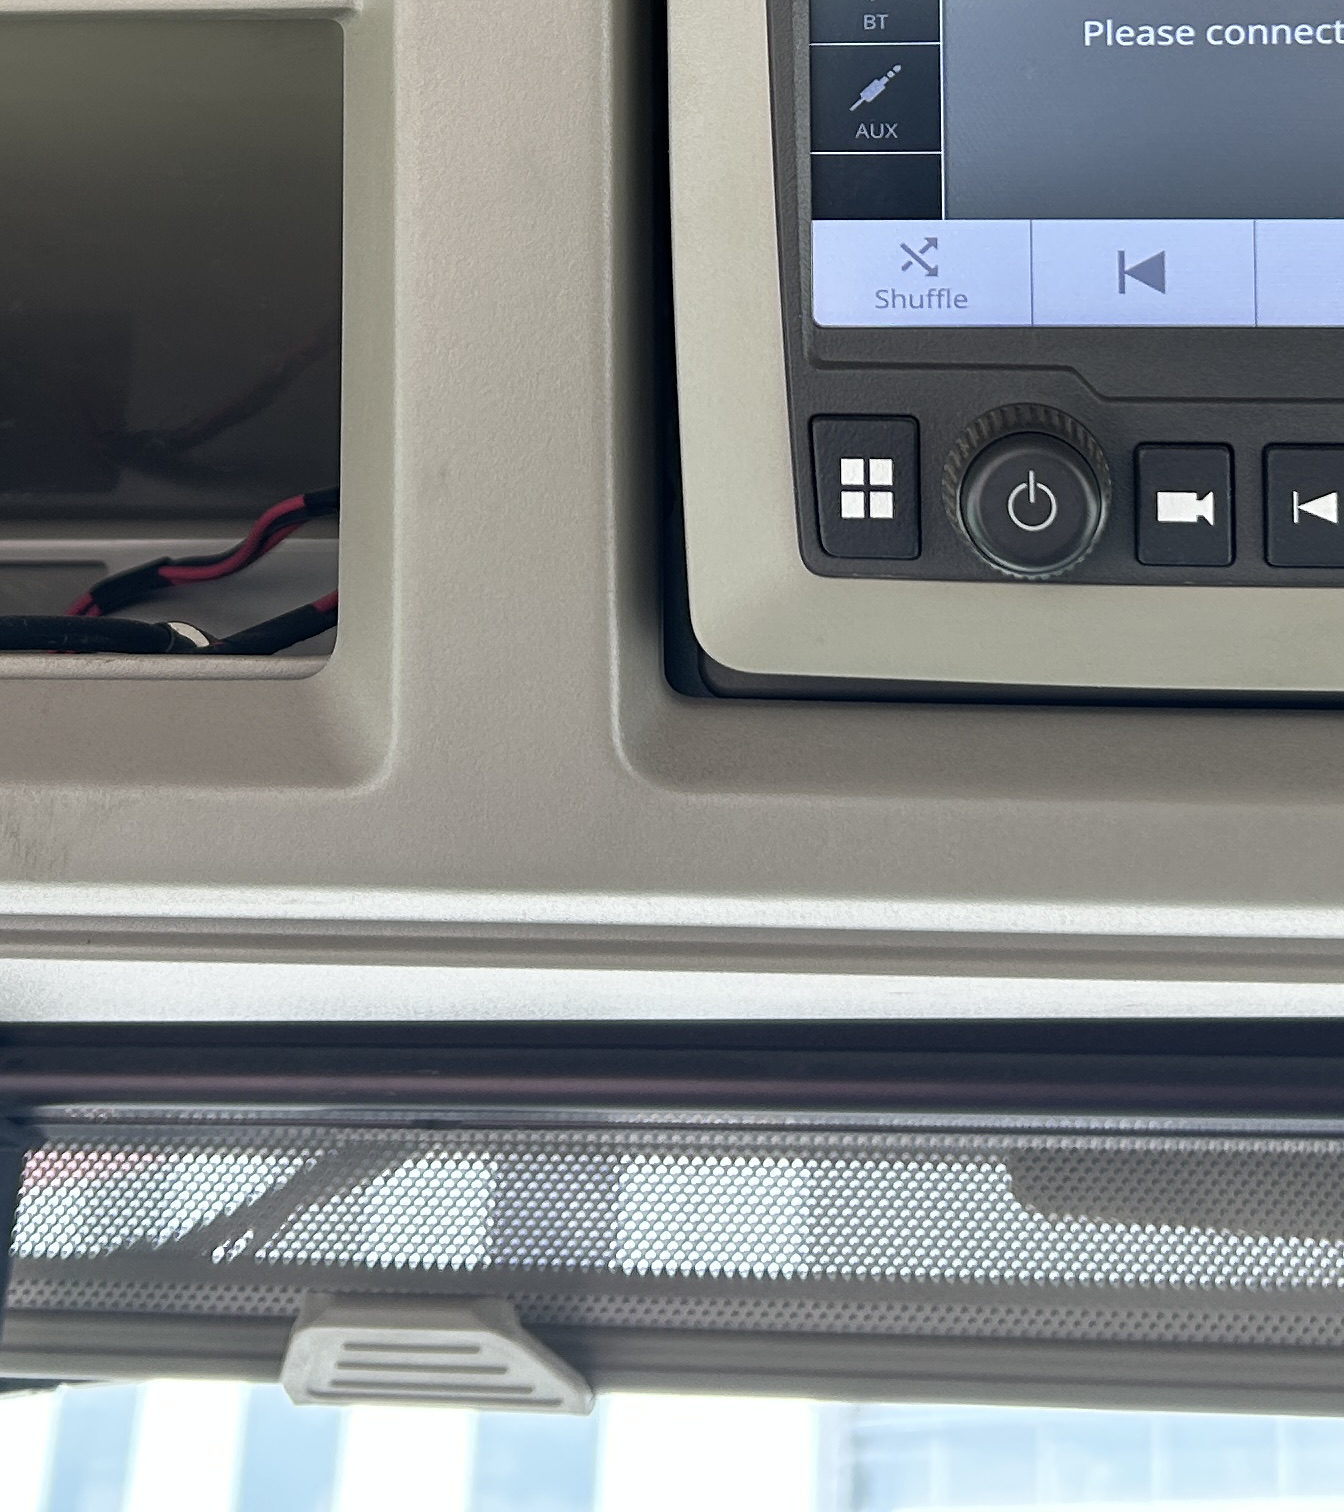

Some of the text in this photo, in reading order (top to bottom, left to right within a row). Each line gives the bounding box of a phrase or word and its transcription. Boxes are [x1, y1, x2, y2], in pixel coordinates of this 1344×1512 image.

[863, 13, 889, 31] BT
[1083, 19, 1195, 48] Please
[855, 122, 898, 140] AUX
[875, 287, 968, 310] Shuffle
